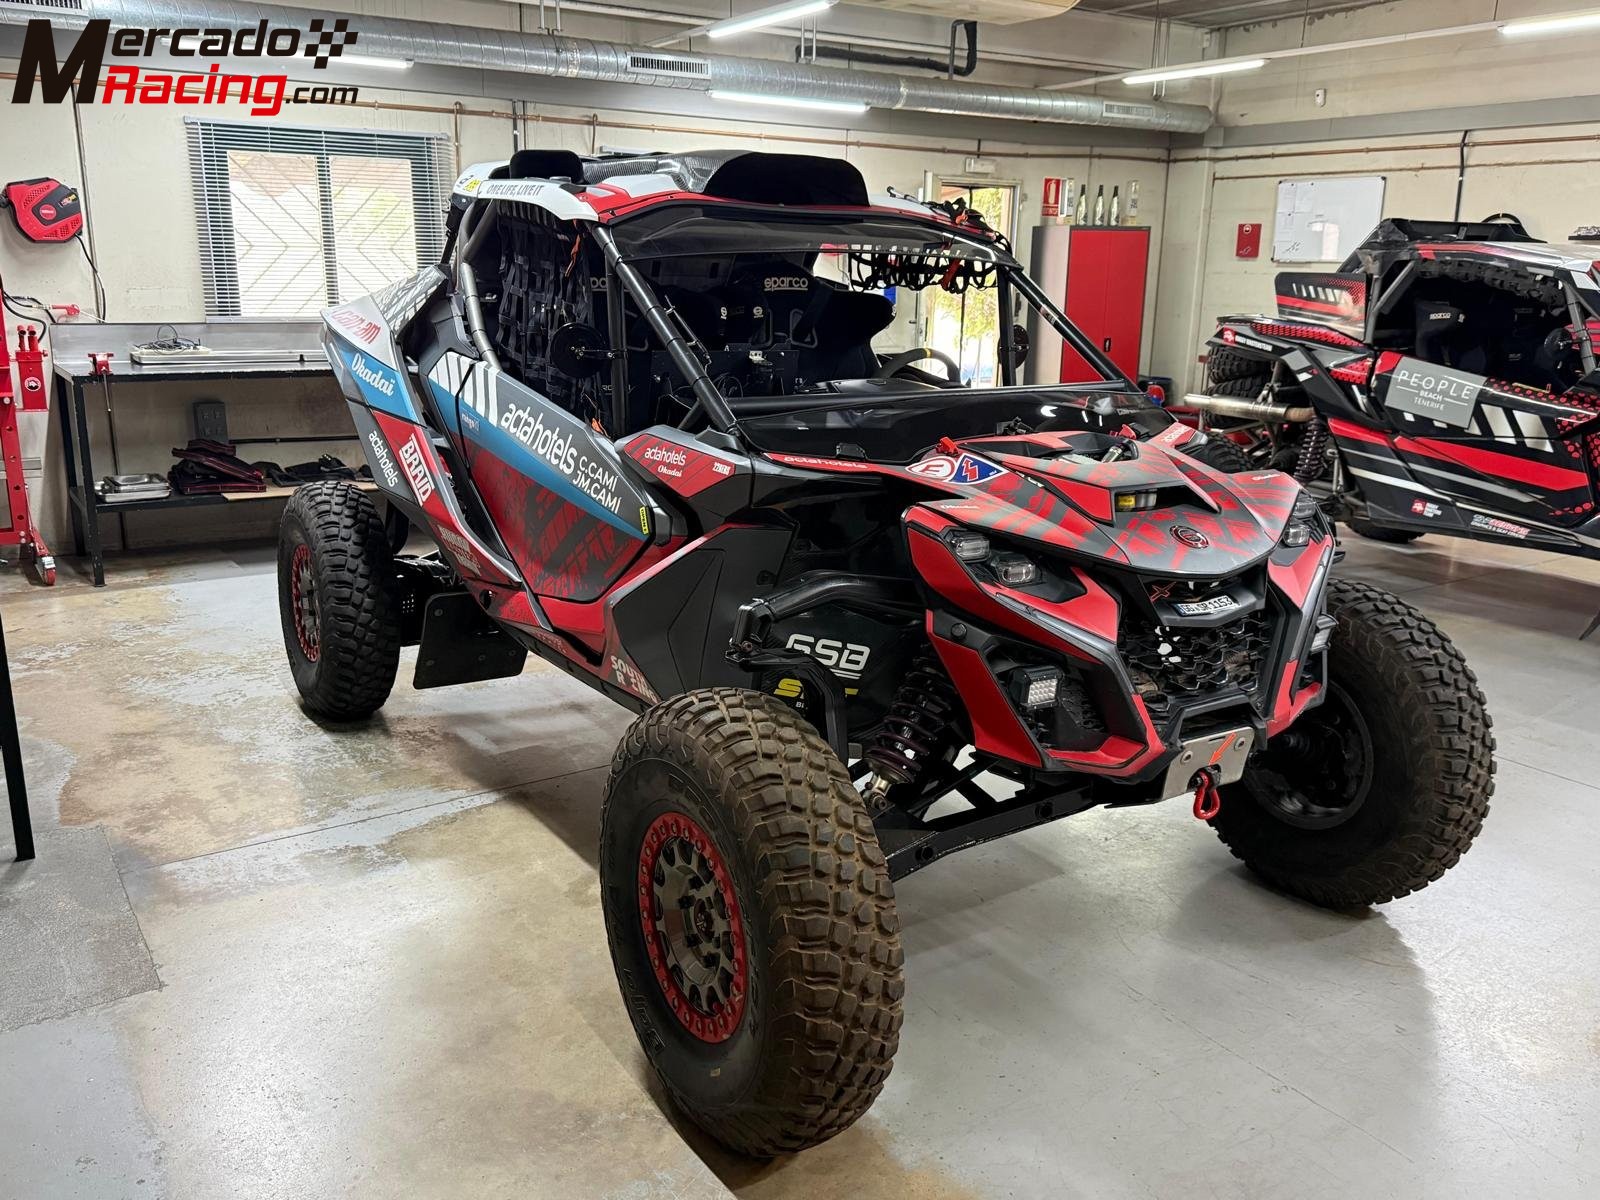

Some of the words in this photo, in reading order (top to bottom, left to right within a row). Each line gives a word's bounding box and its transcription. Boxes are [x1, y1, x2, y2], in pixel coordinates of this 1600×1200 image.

[486, 184, 501, 195] ONE
[764, 276, 808, 291] sparco
[1397, 370, 1474, 400] PEOPLE
[1419, 390, 1443, 401] BEACH
[1414, 397, 1445, 411] TENERIFE
[501, 403, 578, 475] actahotels
[368, 430, 398, 487] actahotels
[644, 446, 687, 466] actahotels
[400, 442, 433, 503] BRAID
[579, 455, 619, 491] C.CAMÍ
[572, 470, 622, 514] JM.CAMÍ
